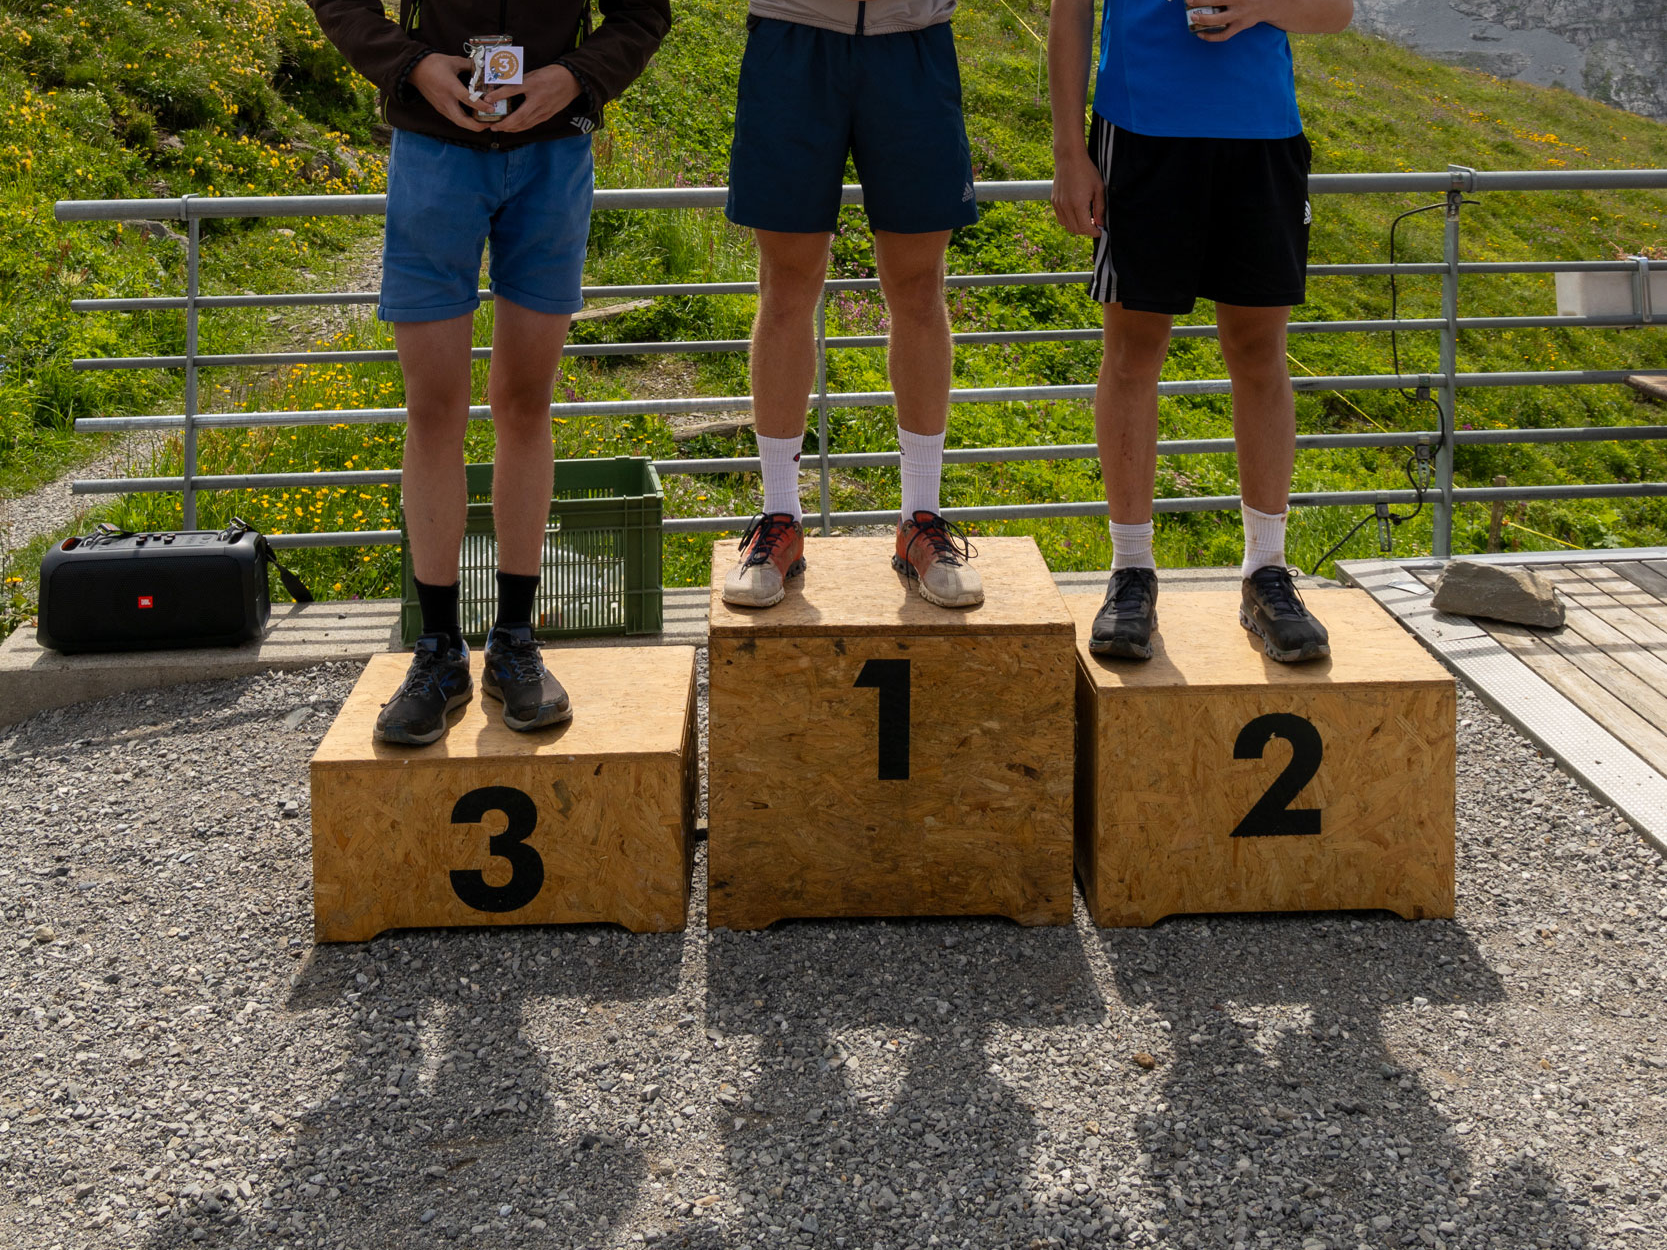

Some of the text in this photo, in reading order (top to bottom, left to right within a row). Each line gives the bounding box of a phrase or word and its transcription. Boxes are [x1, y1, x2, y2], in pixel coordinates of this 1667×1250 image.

[498, 58, 510, 72] 3
[853, 658, 911, 781] 1
[1229, 713, 1323, 837] 2
[449, 786, 545, 913] 3
